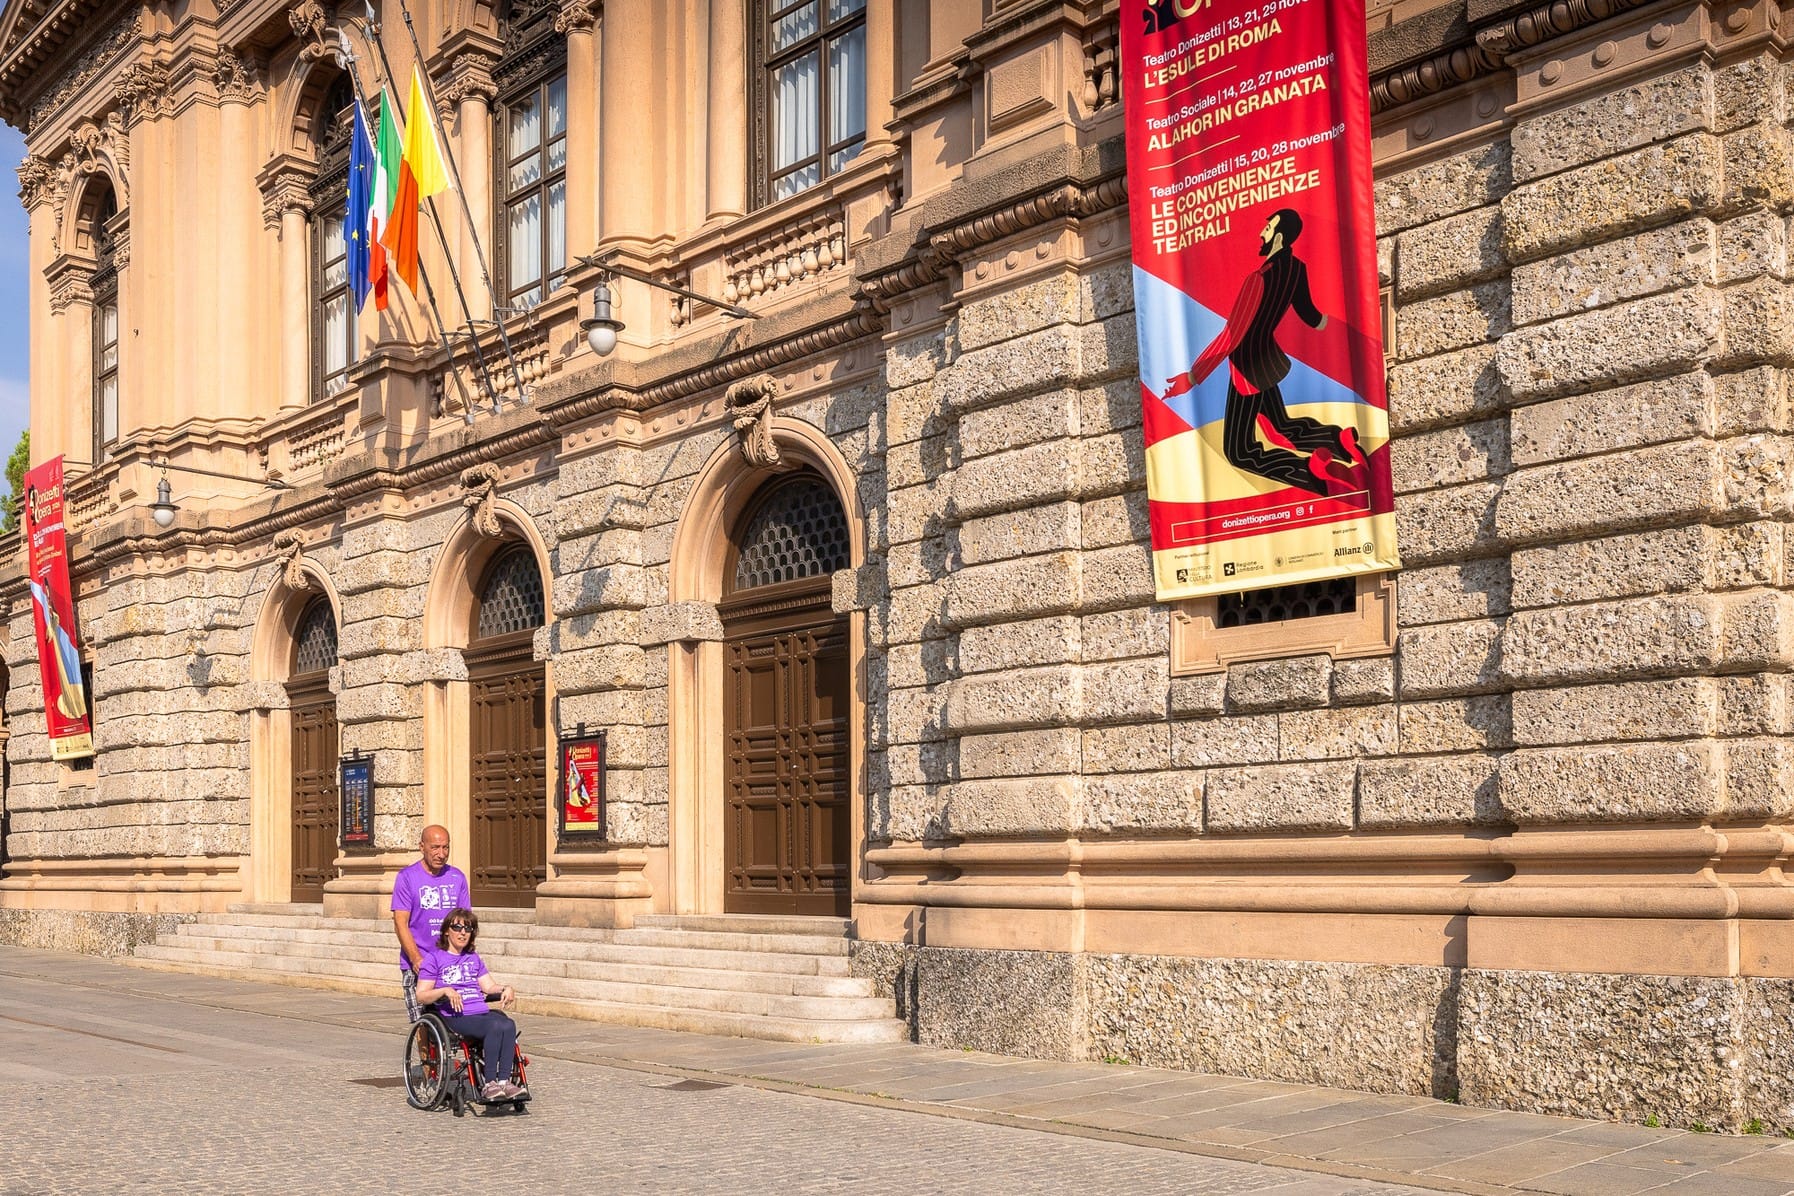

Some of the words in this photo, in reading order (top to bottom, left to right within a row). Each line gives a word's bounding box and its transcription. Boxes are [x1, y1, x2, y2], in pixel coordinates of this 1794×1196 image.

[1143, 48, 1177, 67] Teatro
[1178, 23, 1221, 55] Donizetti
[1227, 16, 1243, 31] 13,
[1244, 9, 1261, 24] 21,
[1262, 1, 1277, 18] 29
[1208, 40, 1225, 62] DI
[1227, 18, 1282, 53] ROMA
[1146, 112, 1180, 131] Teatro
[1180, 94, 1217, 119] Sociale
[1222, 85, 1239, 100] 14,
[1239, 78, 1257, 94] 22,
[1258, 70, 1273, 87] 27
[1275, 52, 1334, 81] novembre
[1147, 113, 1213, 152] ALAHOR
[1215, 104, 1233, 126] IN
[1234, 73, 1327, 117] GRANATA
[1149, 182, 1184, 199] Teatro
[1184, 160, 1229, 188] Donizetti
[1233, 153, 1250, 168] 15,
[1250, 147, 1270, 163] 20,
[1271, 140, 1288, 157] 28
[1289, 122, 1345, 151] novembre
[1151, 199, 1176, 220] LE
[1176, 156, 1297, 213] CONVENIENZE
[1152, 218, 1179, 238] ED
[1179, 169, 1321, 231] INCONVENIENZE
[1152, 215, 1231, 255] TEATRALI
[1222, 510, 1291, 529] donizettiopera.org
[1334, 546, 1361, 558] Allianz
